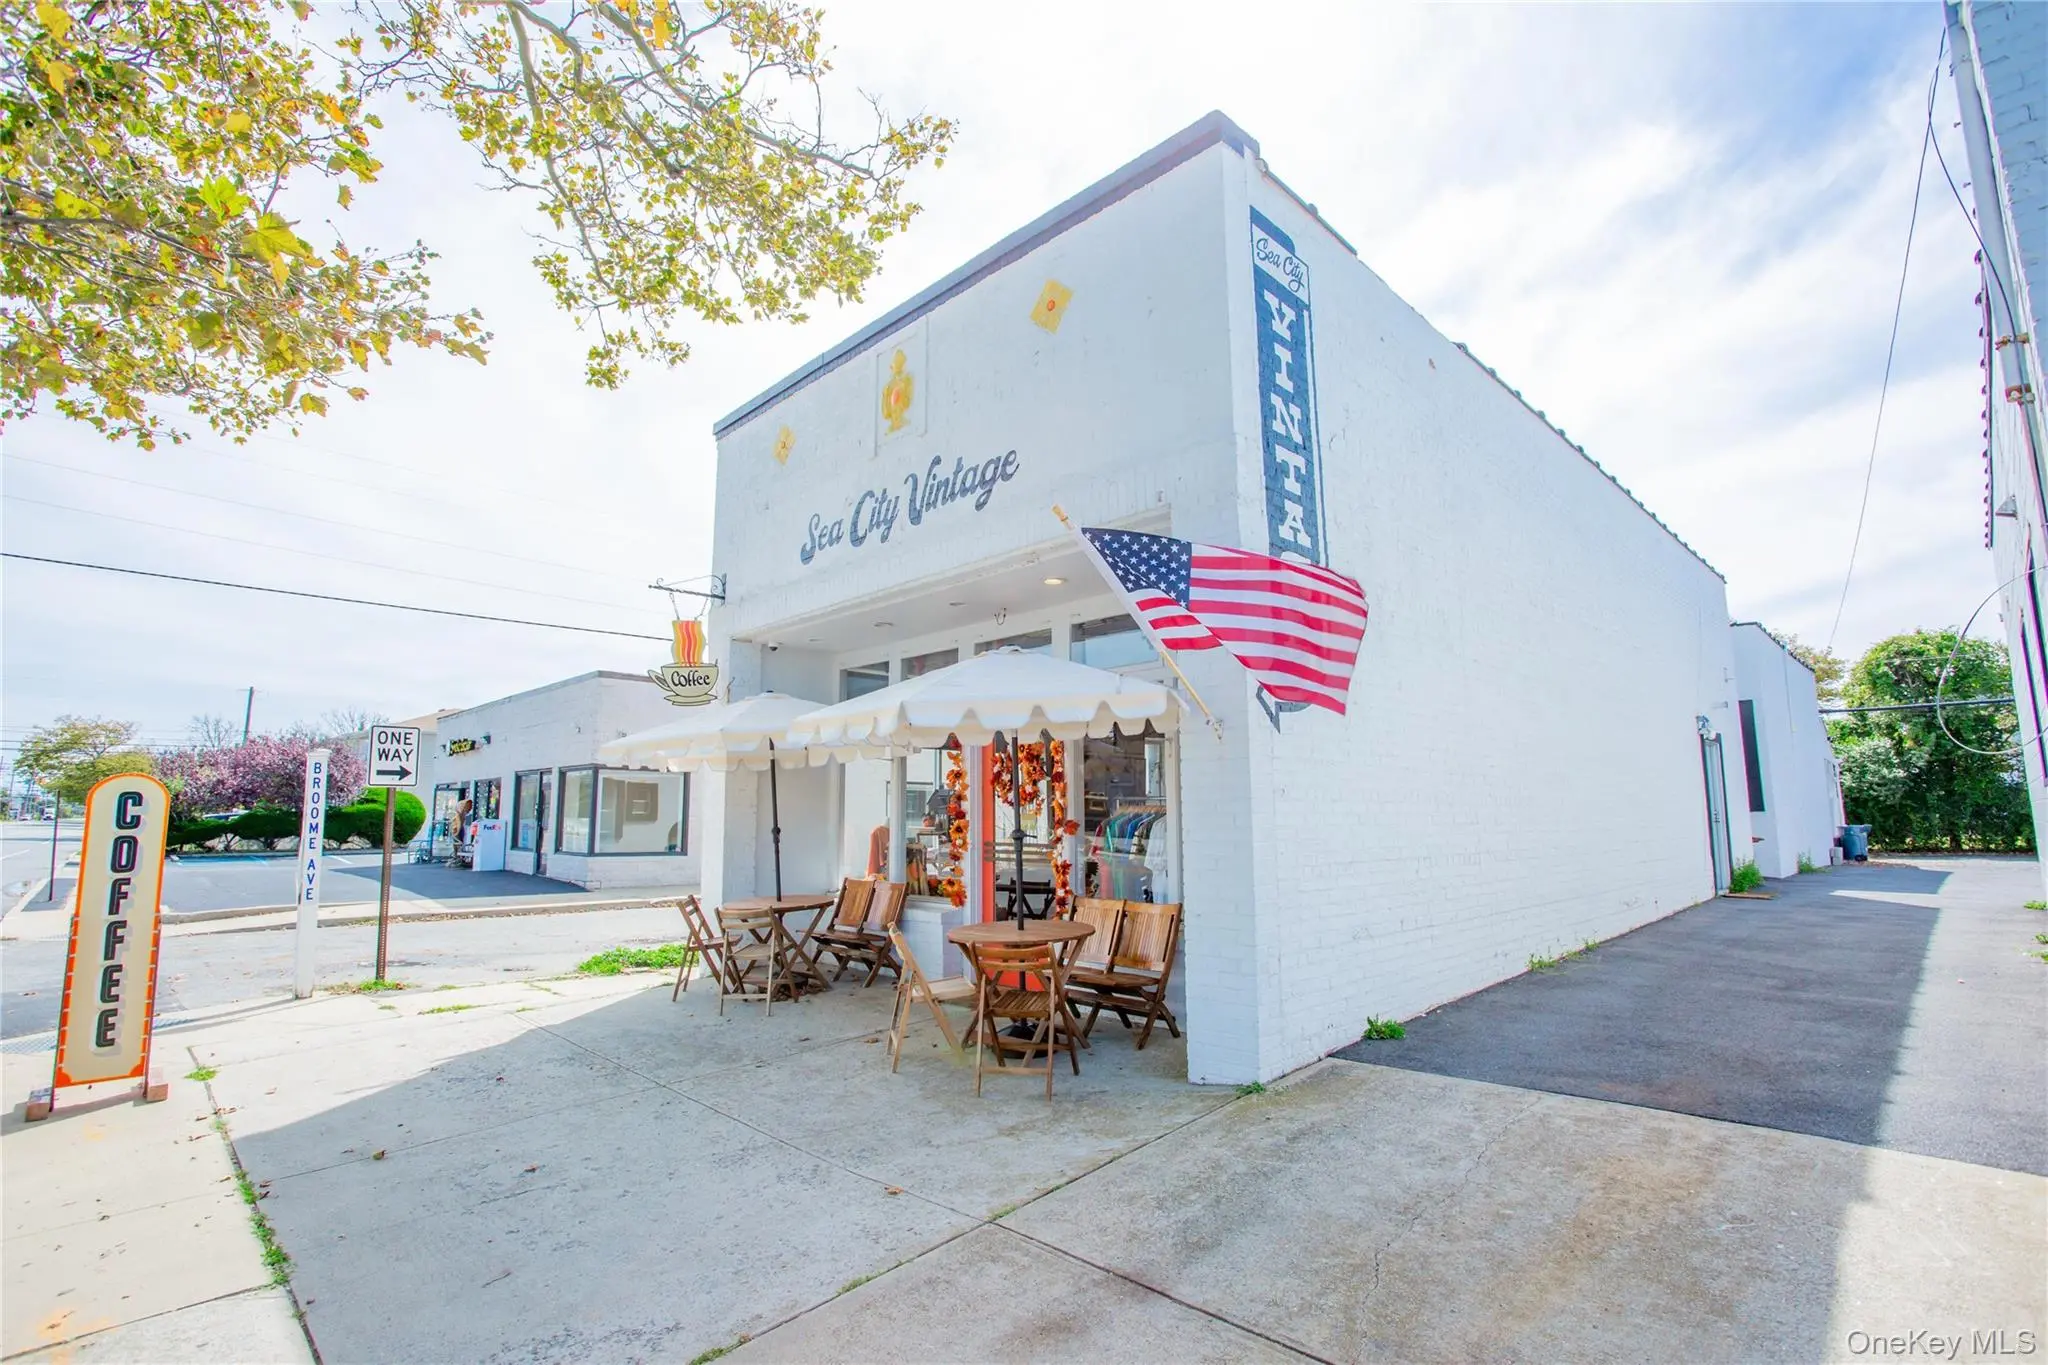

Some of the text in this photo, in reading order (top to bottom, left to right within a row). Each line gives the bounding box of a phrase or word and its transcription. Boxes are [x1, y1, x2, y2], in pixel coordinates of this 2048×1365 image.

[1256, 238, 1305, 293] Sea City
[1263, 288, 1313, 564] VINTA
[800, 449, 1020, 566] Sea City Vintage
[671, 670, 712, 687] Coffee
[377, 730, 414, 746] ONE
[377, 748, 414, 762] WAY
[305, 762, 322, 901] BROOME AVE
[94, 790, 143, 1049] COFFEE
